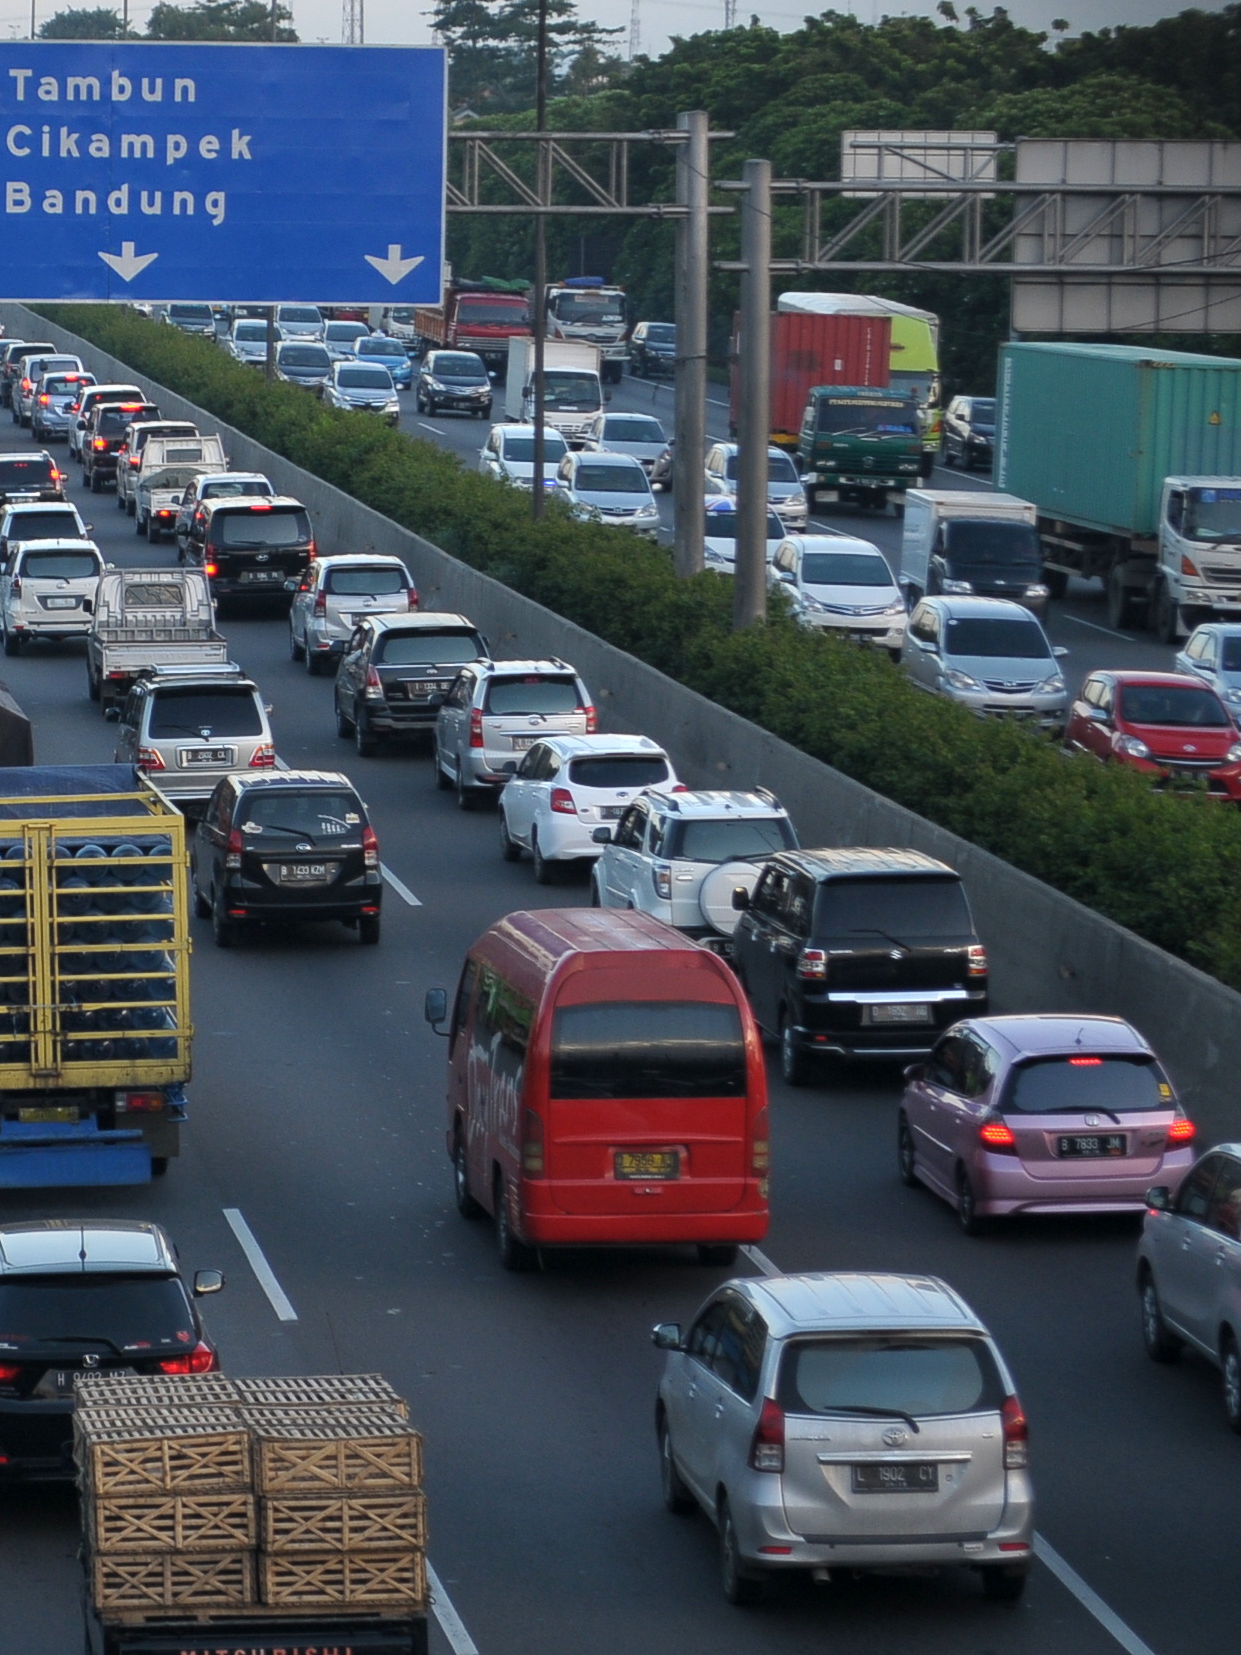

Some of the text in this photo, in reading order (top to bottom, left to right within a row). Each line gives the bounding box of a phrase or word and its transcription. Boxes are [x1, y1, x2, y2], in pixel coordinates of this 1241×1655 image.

[10, 69, 195, 101] Tambun
[7, 125, 251, 164] Cikampek
[6, 182, 224, 225] Bandung
[281, 865, 287, 875] B
[1062, 1139, 1068, 1151] B
[1075, 1138, 1098, 1150] 7833
[58, 1372, 65, 1386] H
[858, 1466, 933, 1481] L 1902 CY
